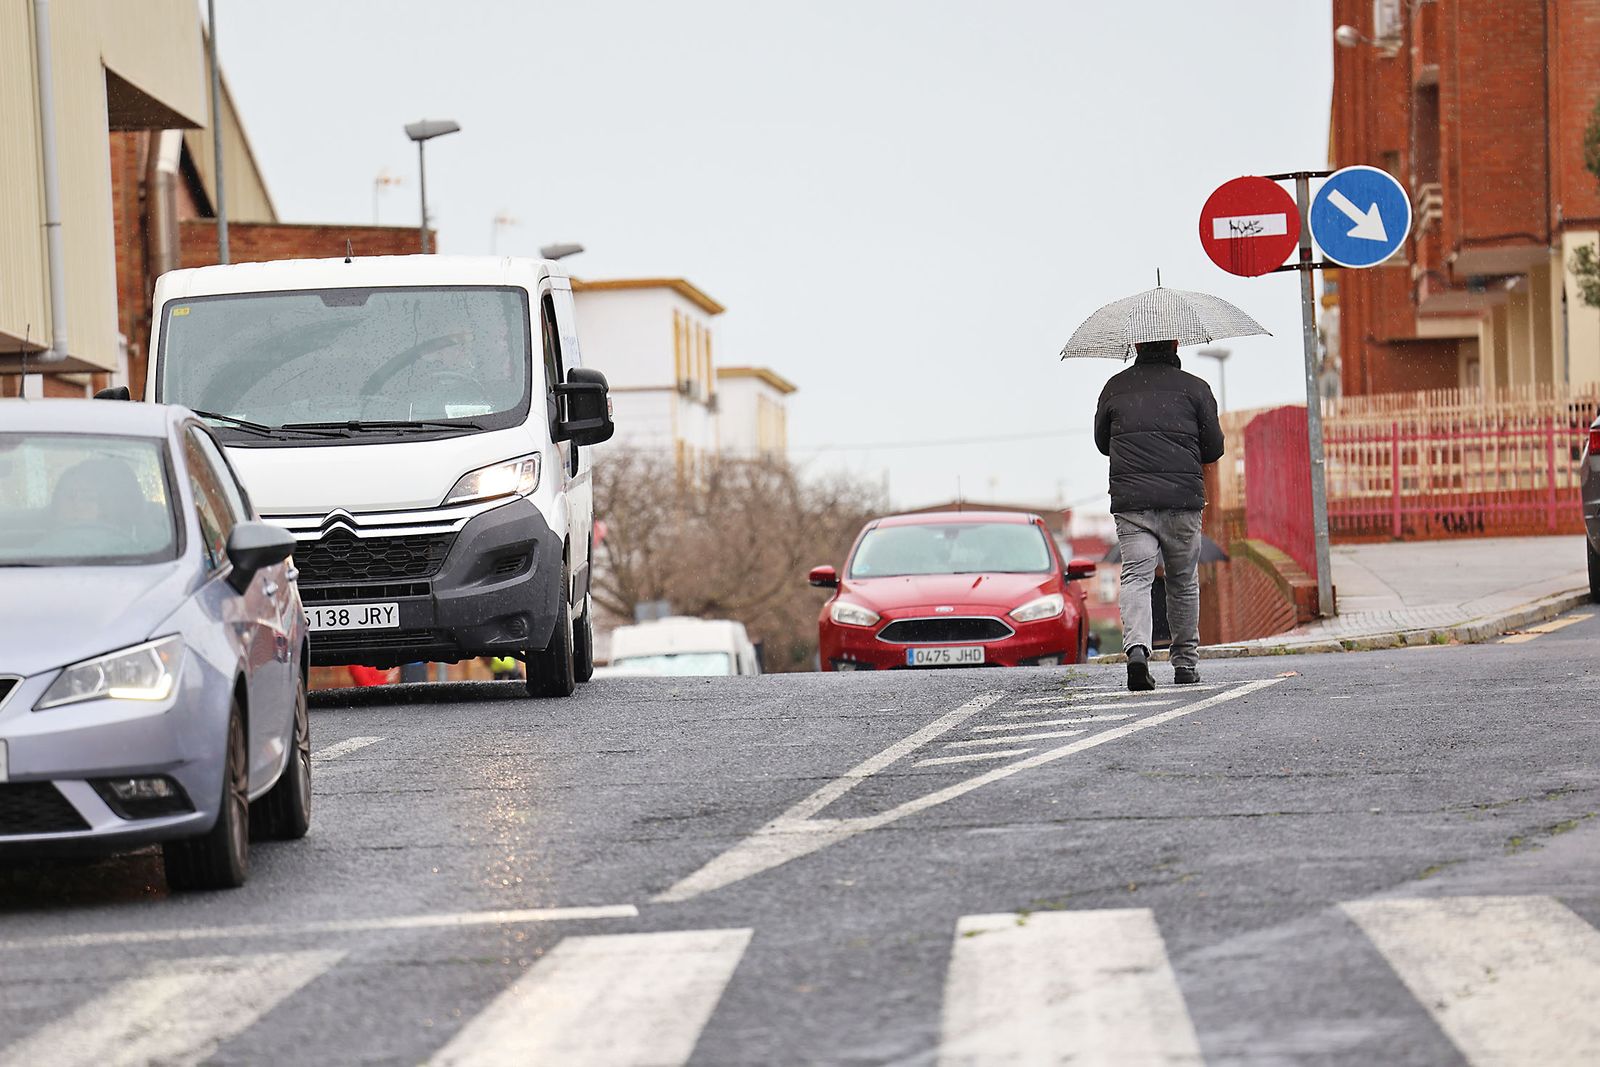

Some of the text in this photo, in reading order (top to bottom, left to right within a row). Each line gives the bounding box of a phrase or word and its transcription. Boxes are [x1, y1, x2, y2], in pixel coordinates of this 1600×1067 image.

[358, 606, 394, 625] JRY
[916, 648, 982, 663] 0475 JHD
